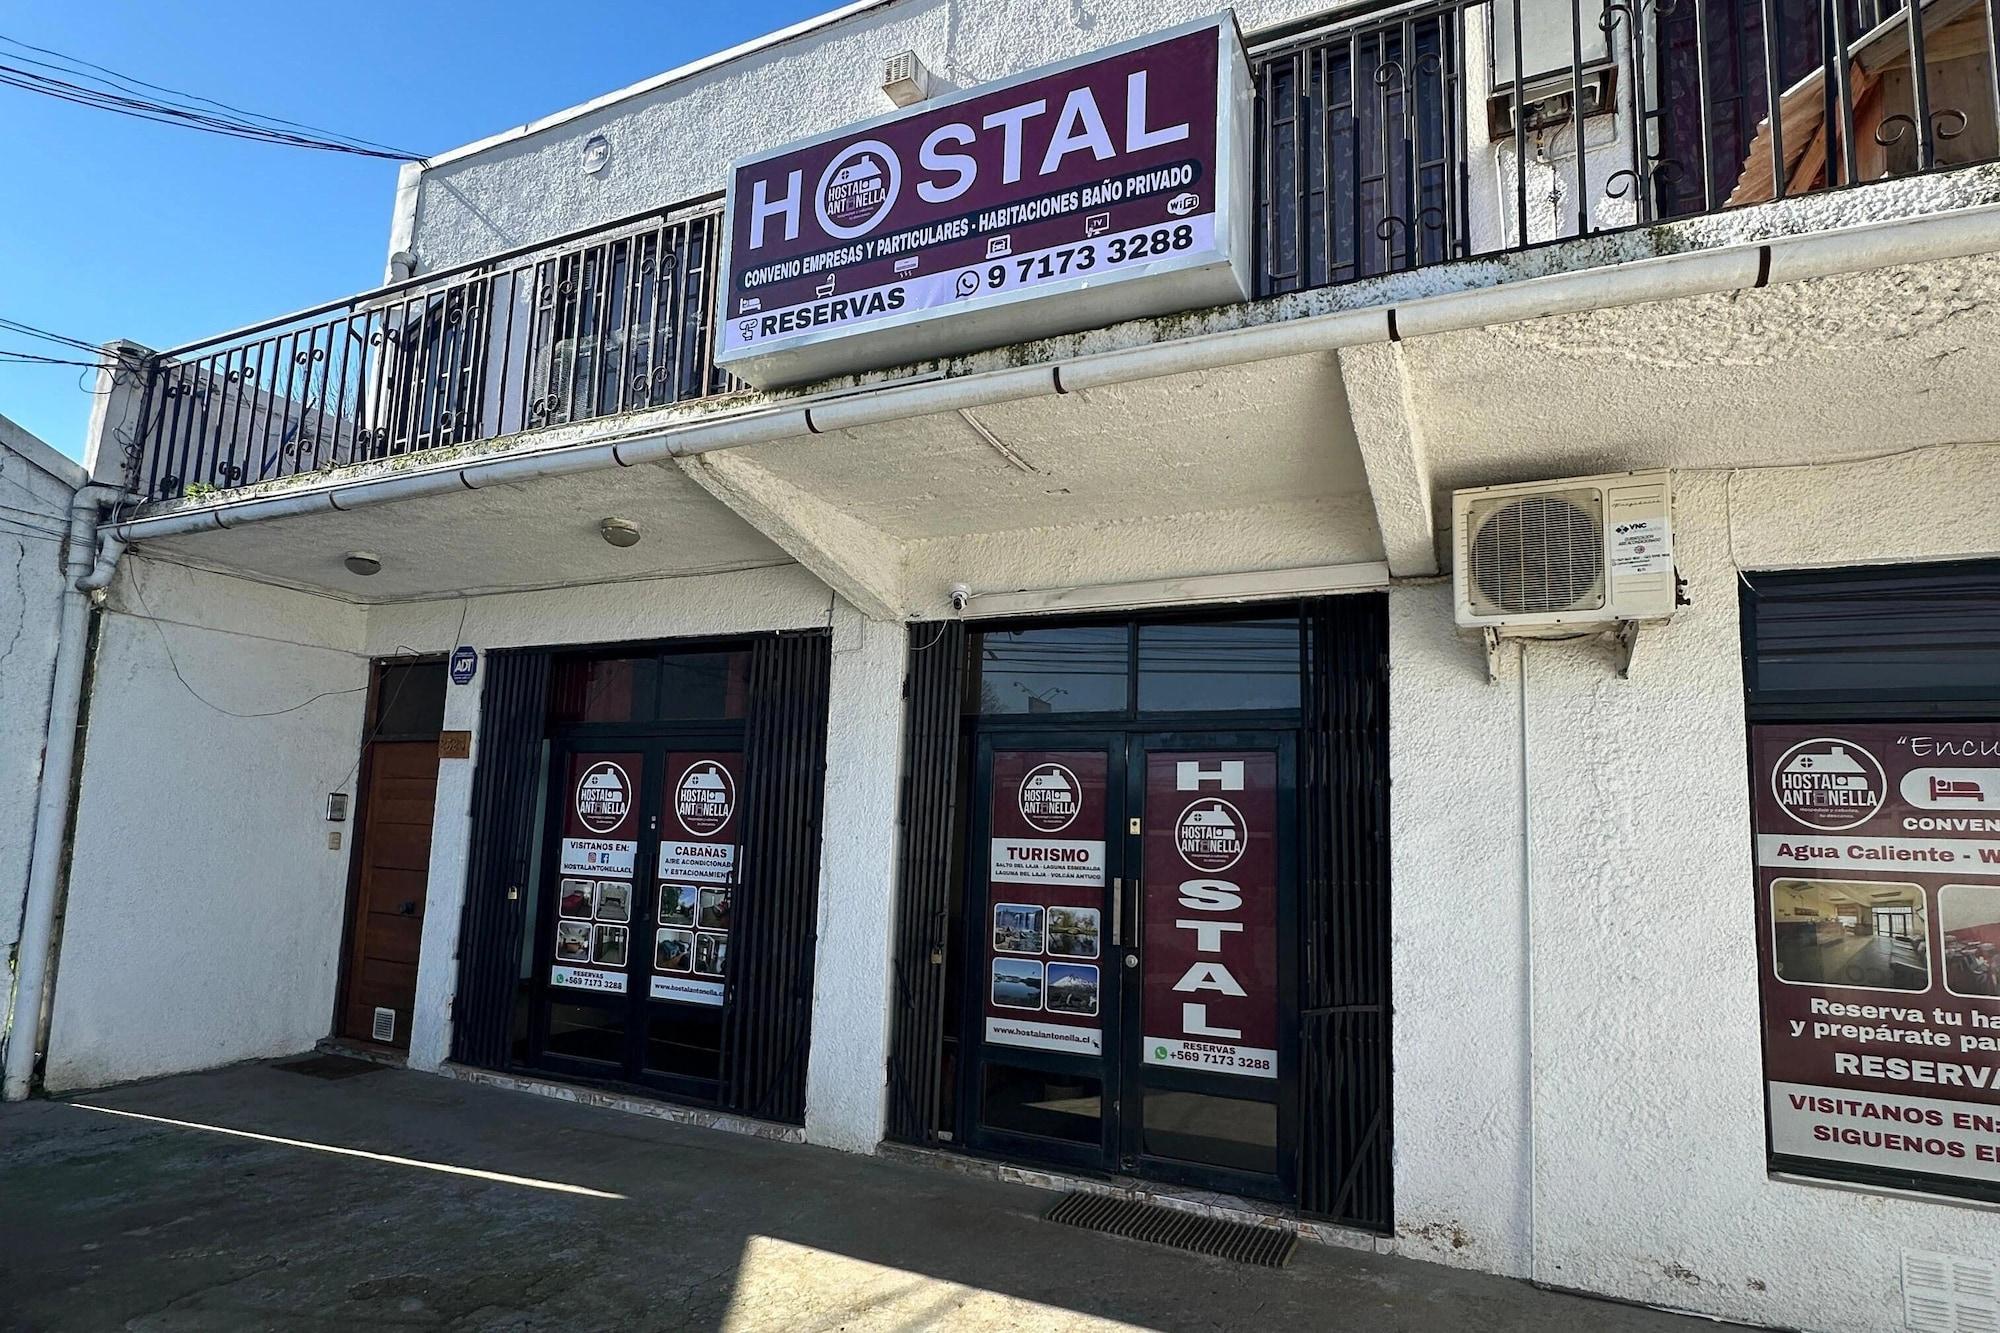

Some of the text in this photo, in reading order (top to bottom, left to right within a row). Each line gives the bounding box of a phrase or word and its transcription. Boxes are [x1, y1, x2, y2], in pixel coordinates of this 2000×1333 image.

[828, 180, 863, 202] HOSTAL
[744, 259, 800, 289] CONVENIO
[802, 244, 863, 275] EMPRESAS
[866, 241, 875, 260] Y
[876, 217, 969, 257] PARTICULARES
[978, 191, 1079, 233] HABITACIONES
[1082, 176, 1122, 206] BAÑO
[1126, 164, 1193, 198] PRIVADO
[1093, 218, 1103, 227] TV
[988, 224, 1193, 289] 9 7173 3288
[760, 287, 905, 338] RESERVAS
[1629, 522, 1647, 530] VNC
[454, 658, 474, 672] ADT
[1782, 773, 1837, 790] HOSTAL
[581, 789, 608, 802] HOSTAL
[680, 789, 709, 803] HOSTAL
[1024, 789, 1055, 801] HOSTAL
[1902, 817, 2000, 832] CONVEN
[1181, 826, 1217, 839] HOSTAL
[570, 841, 613, 851] VISITANOS
[675, 845, 727, 858] CABAÑAS
[1777, 843, 1840, 861] Agua
[1847, 844, 1955, 862] Caliente
[1007, 847, 1089, 862] TURISMO
[670, 868, 728, 878] ESTACIONAMIEN
[573, 970, 604, 979] RESERVAS
[565, 976, 622, 990] +569 7173 3288
[654, 983, 724, 996] www.hostalantonella.c
[1810, 997, 1925, 1023] Reserva
[1932, 1007, 1962, 1026] tu
[993, 1026, 1090, 1043] www.hostalantonella.cl
[1790, 1019, 1806, 1037] y
[1814, 1022, 1951, 1047] prepárate
[1183, 1042, 1236, 1055] RESERVAS
[1169, 1050, 1270, 1070] +569 7173 3288
[1788, 1093, 2000, 1133] VISITANOS EN:
[1813, 1124, 1966, 1158] SIGUENOS
